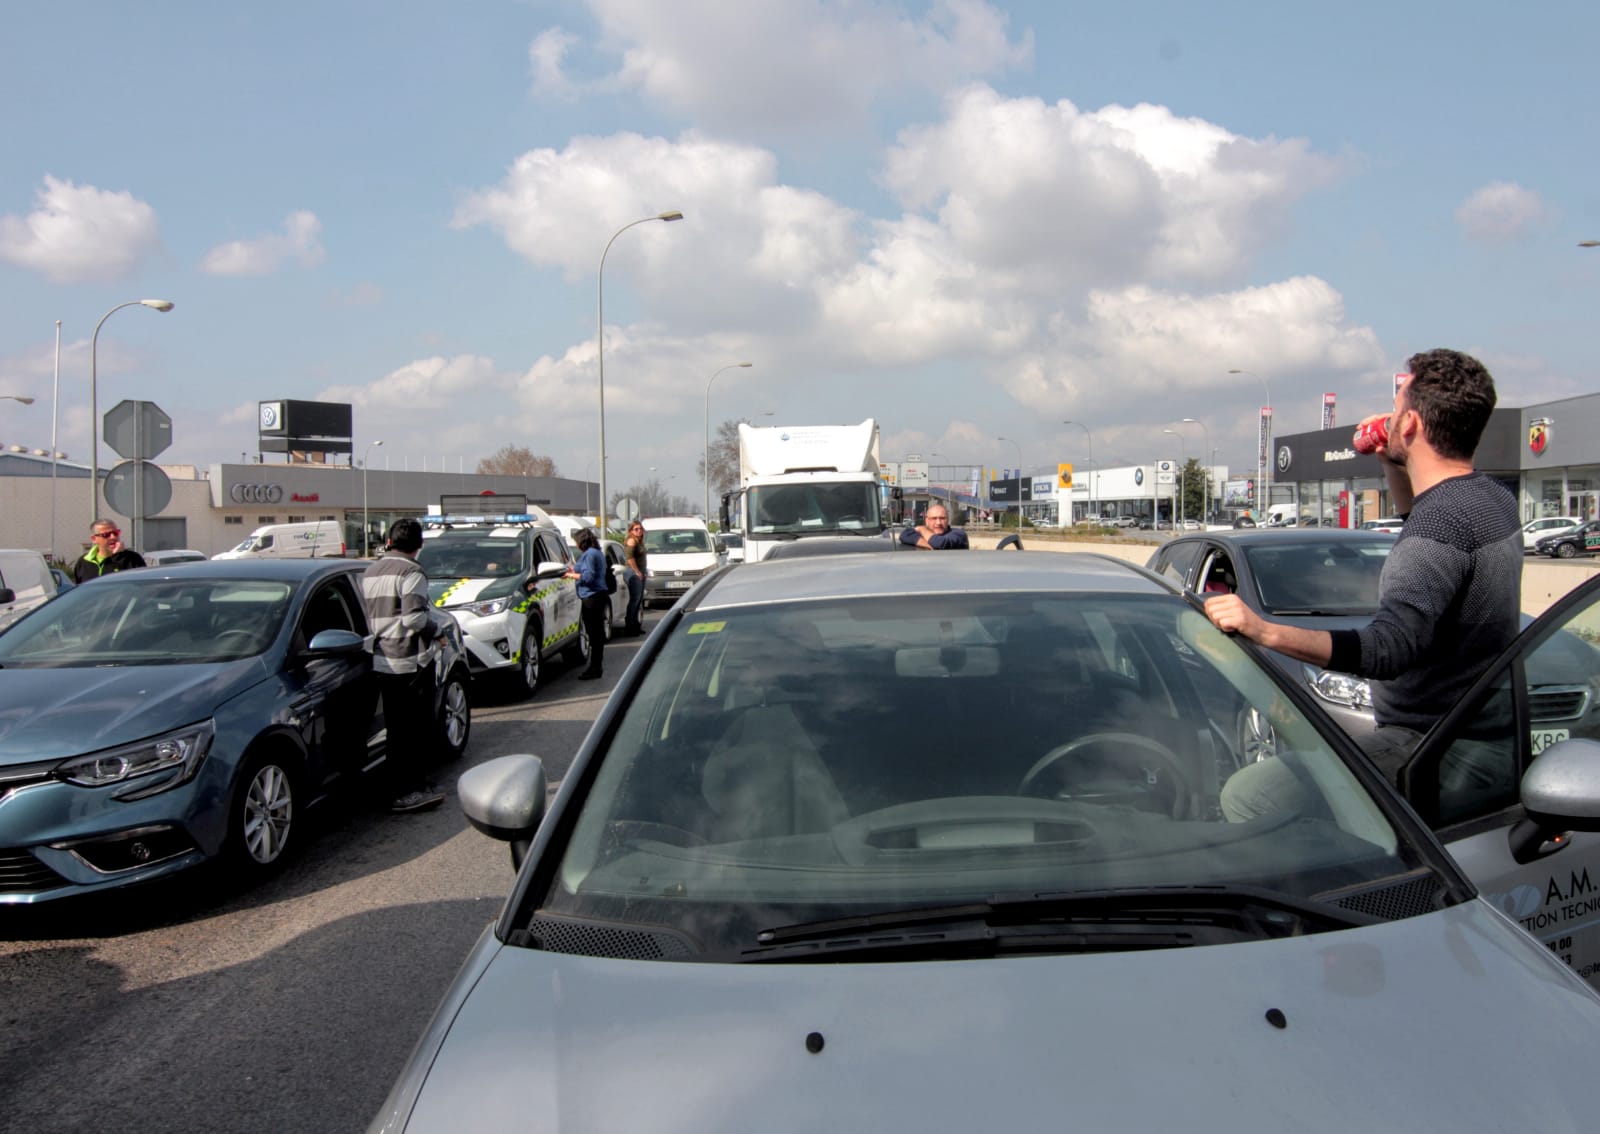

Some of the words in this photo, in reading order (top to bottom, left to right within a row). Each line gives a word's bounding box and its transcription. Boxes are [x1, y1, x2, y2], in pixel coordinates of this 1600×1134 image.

[290, 493, 319, 502] Audi
[1545, 867, 1598, 905] A.M.
[1519, 910, 1558, 931] TION
